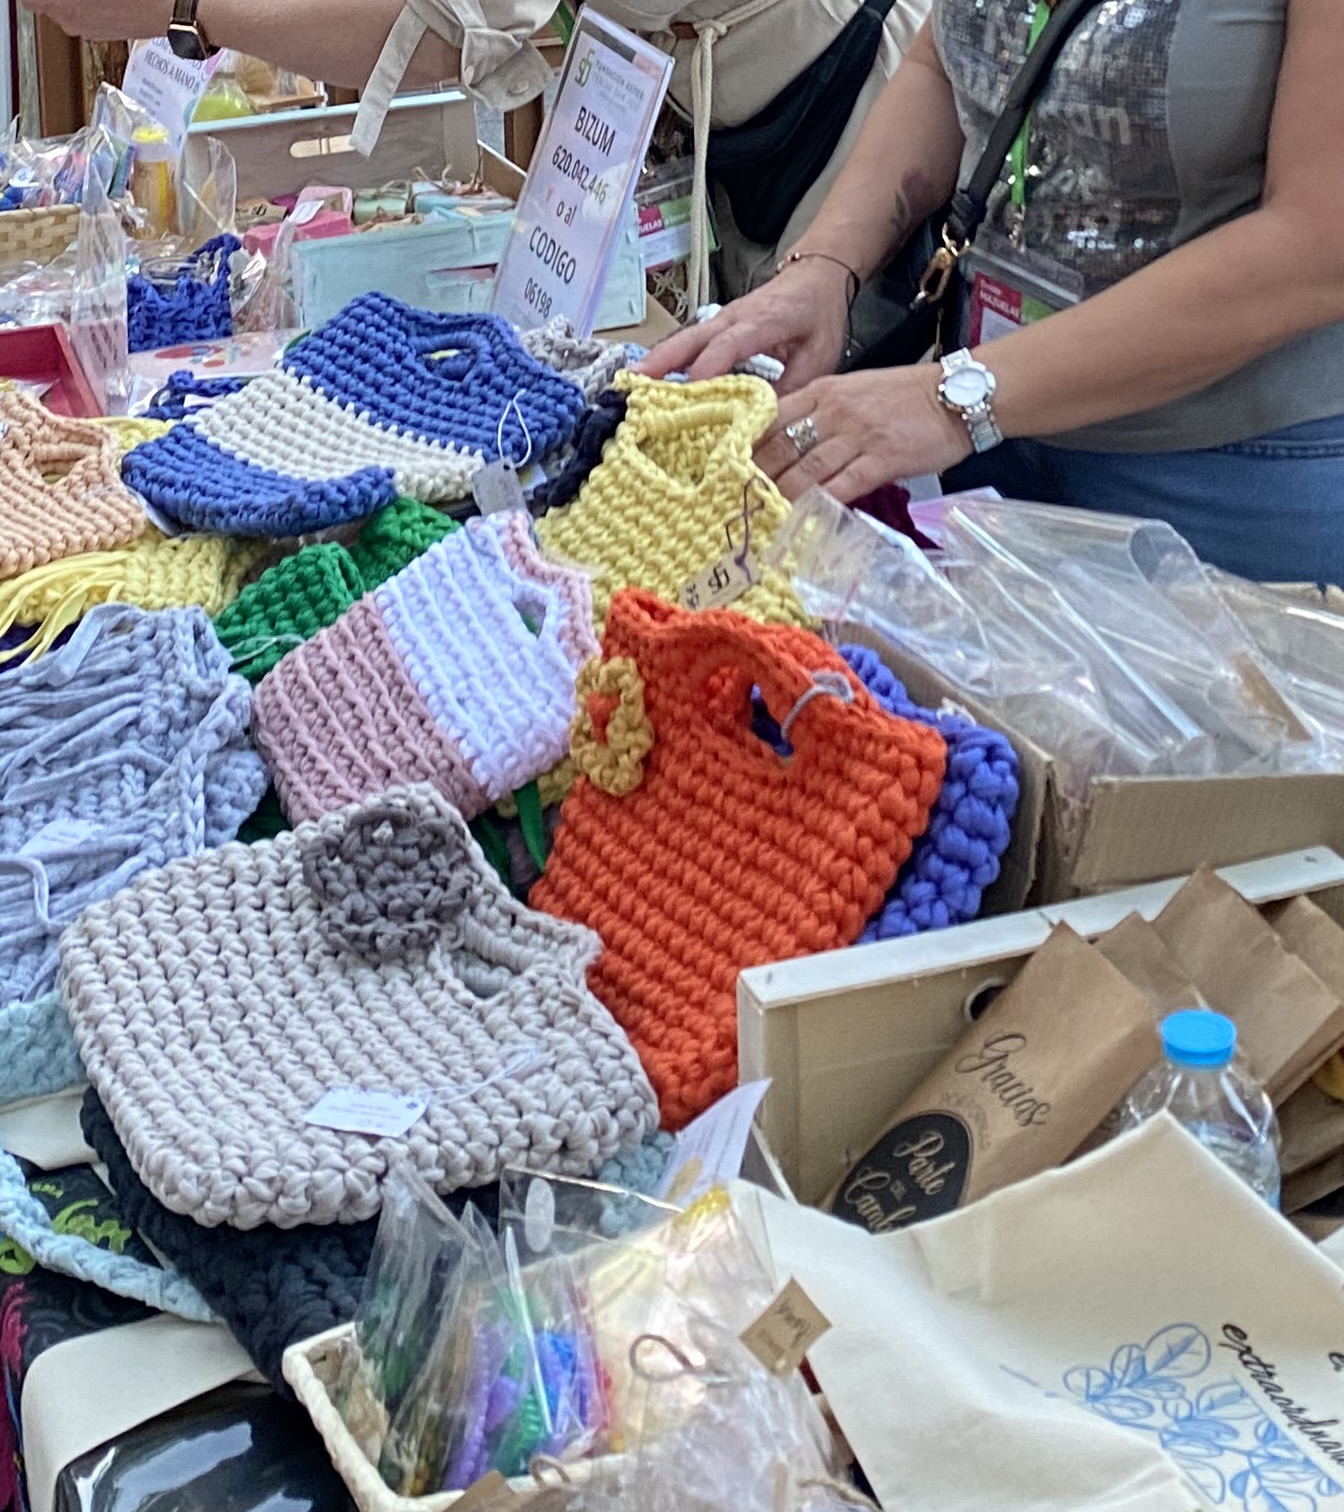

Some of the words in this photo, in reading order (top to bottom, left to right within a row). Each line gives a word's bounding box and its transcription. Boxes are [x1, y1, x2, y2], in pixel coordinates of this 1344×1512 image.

[574, 106, 616, 156] BIZUM
[529, 225, 577, 285] CODIGO
[524, 277, 553, 319] 06198
[955, 1031, 1052, 1128] Gracias
[892, 1130, 956, 1196] Parte
